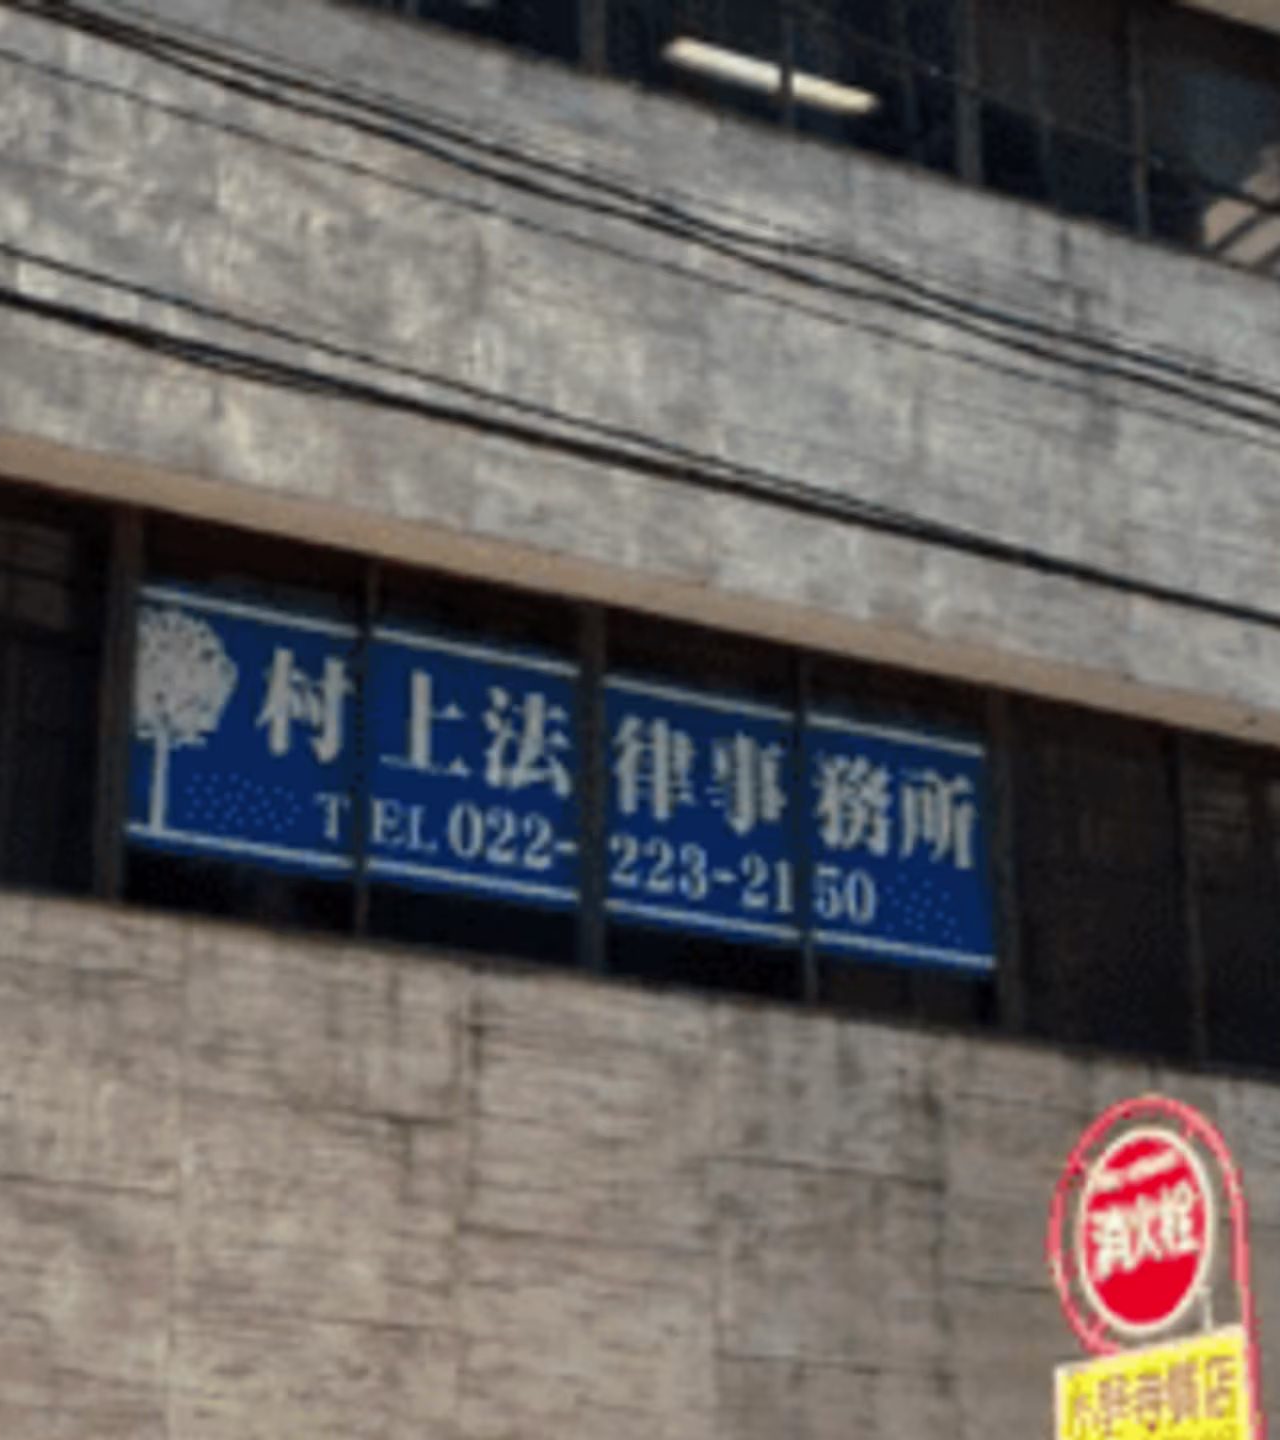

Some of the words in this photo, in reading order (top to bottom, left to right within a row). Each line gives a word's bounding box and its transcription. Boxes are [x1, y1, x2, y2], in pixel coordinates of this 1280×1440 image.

[254, 645, 977, 870] 村上法律事務所
[1091, 1180, 1199, 1278] 消火栓
